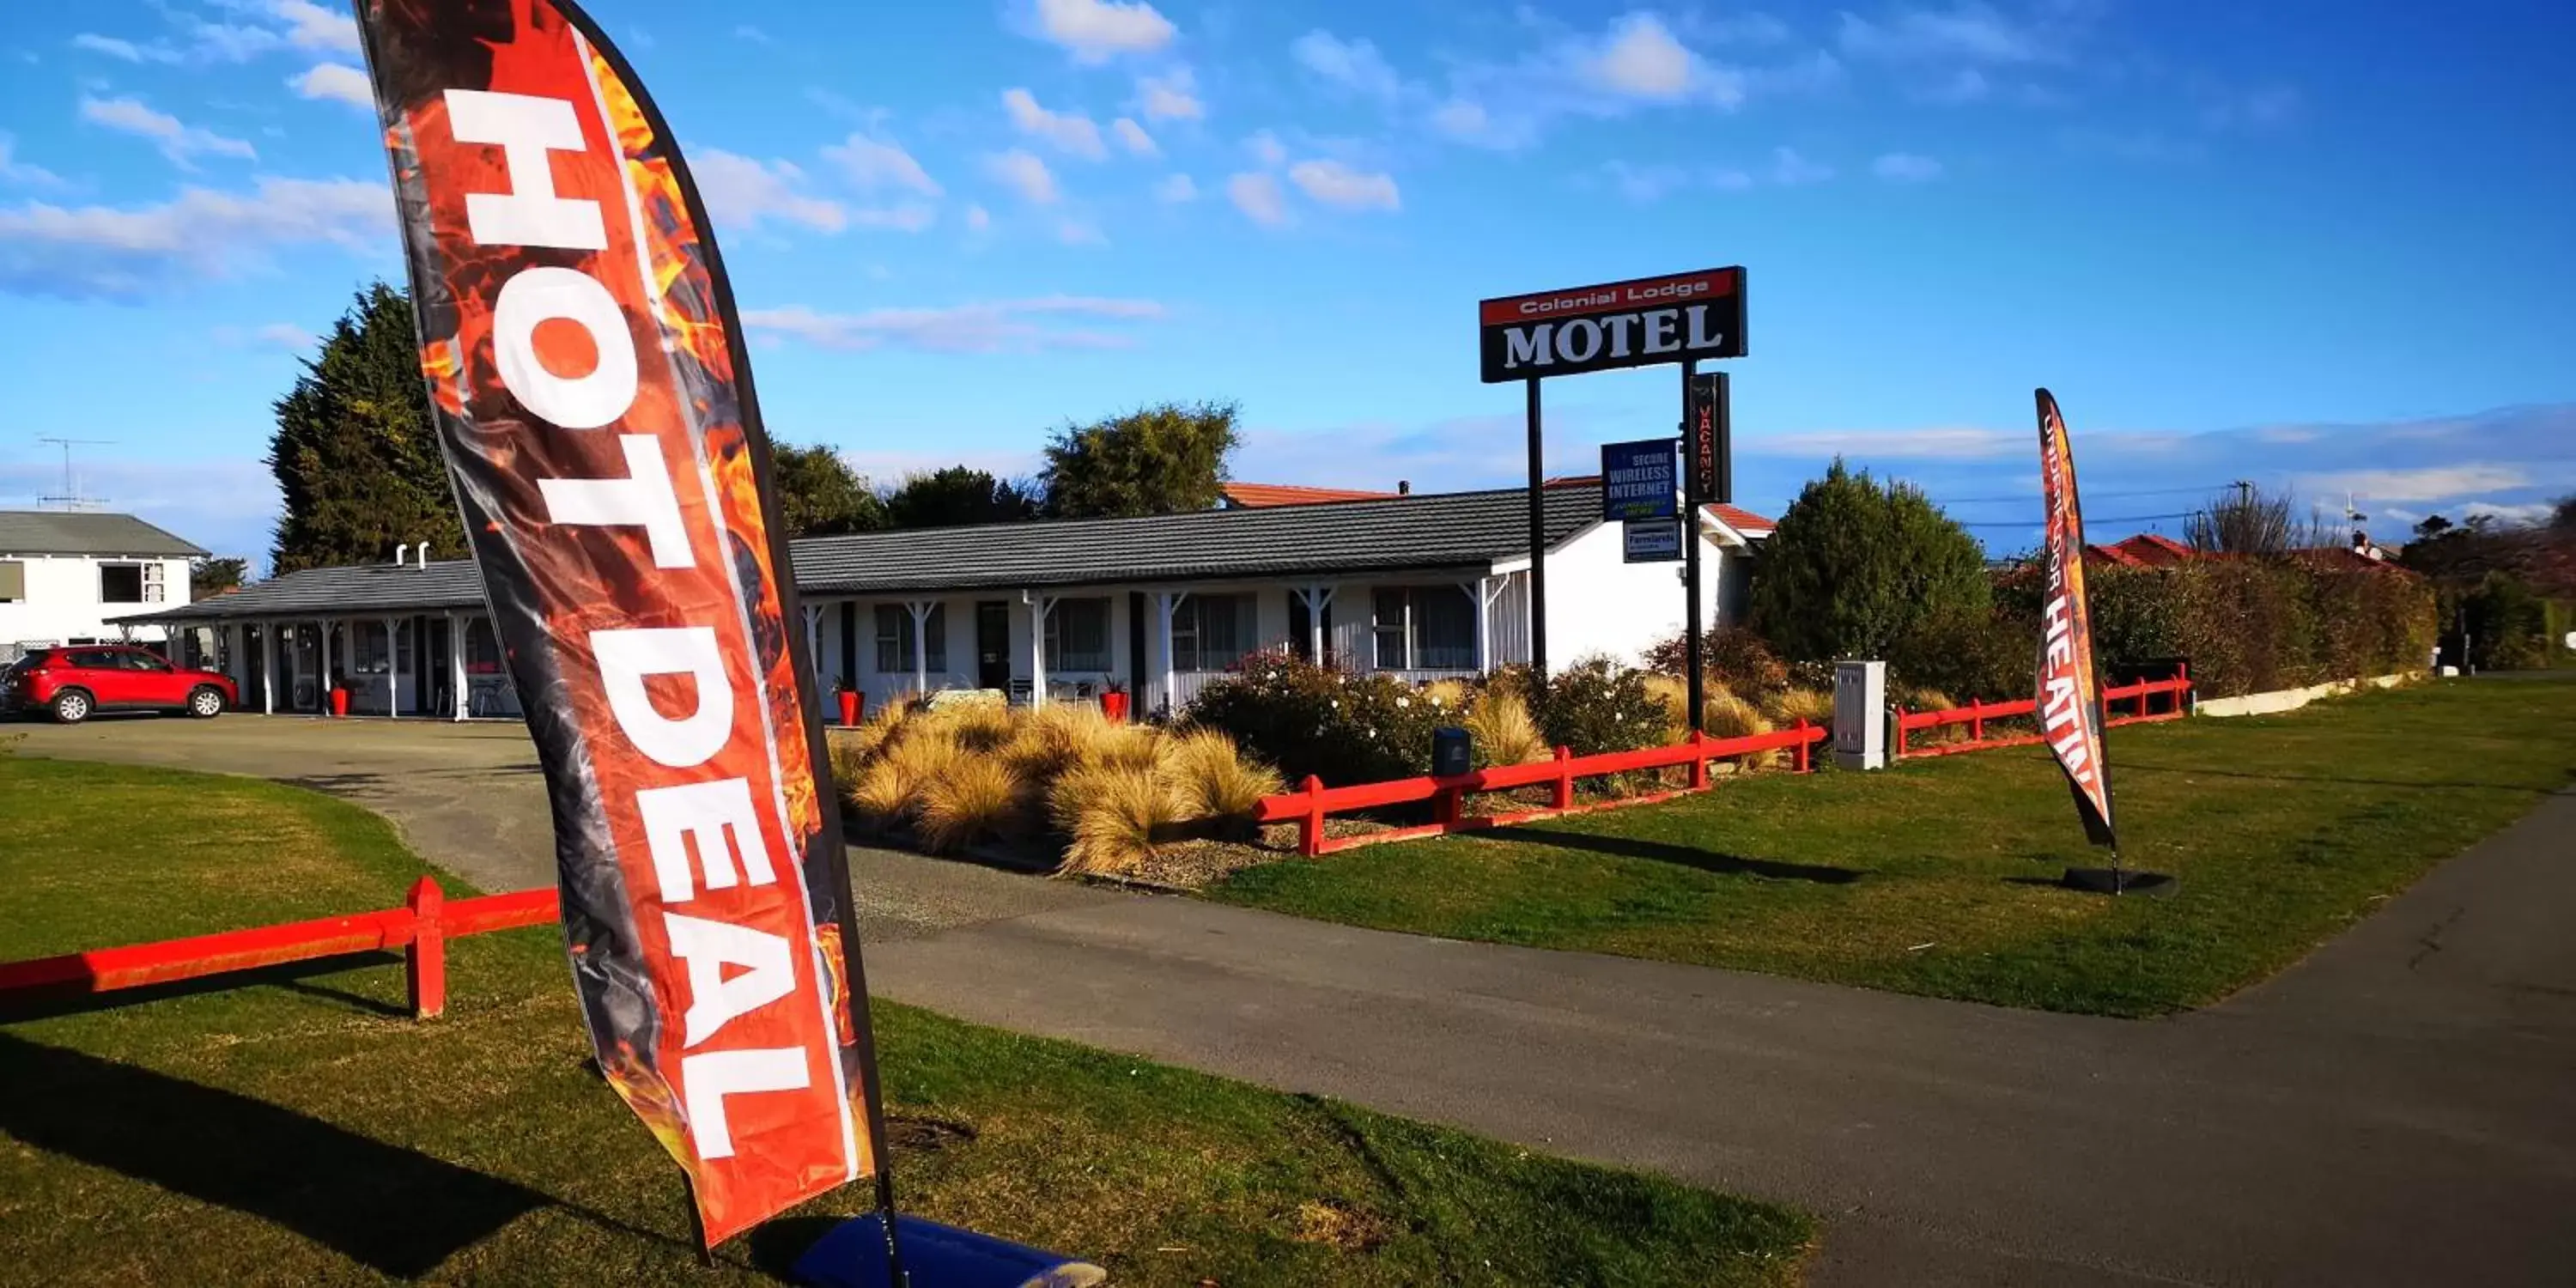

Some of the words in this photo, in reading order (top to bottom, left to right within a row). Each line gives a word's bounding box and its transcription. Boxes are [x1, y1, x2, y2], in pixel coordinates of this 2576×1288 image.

[1521, 293, 1617, 313] Colonial
[1628, 280, 1709, 300] Lodge
[1504, 306, 1722, 368] MOTEL
[1632, 452, 1669, 466] SECURE
[1698, 404, 1712, 494] VACANCY
[1608, 465, 1670, 483] WIRELESS
[1608, 481, 1670, 499] INTERNET
[444, 89, 696, 568] HOT
[590, 626, 810, 1159] DEAL
